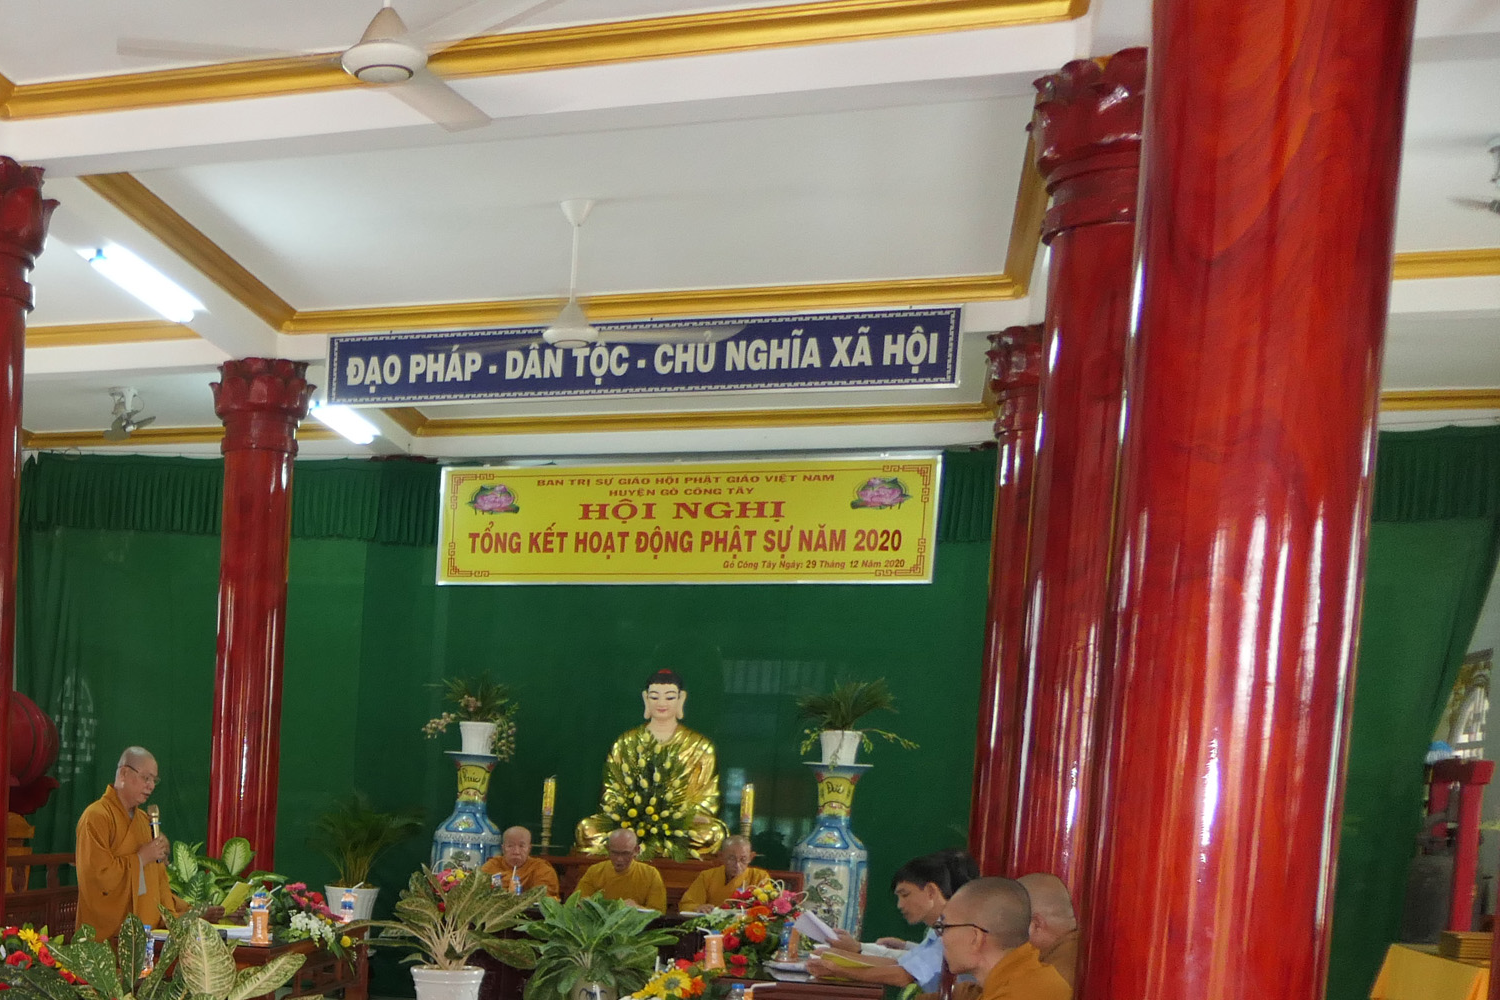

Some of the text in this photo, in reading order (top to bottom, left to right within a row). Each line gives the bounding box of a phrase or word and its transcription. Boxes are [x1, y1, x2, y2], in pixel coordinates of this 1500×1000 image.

[346, 354, 401, 394] ĐẠO
[409, 344, 482, 384] PHÁP
[505, 342, 564, 380] DÂN
[572, 339, 630, 385] TỘC
[653, 329, 717, 375] CHỦ
[724, 328, 822, 372] NGHĨA
[829, 325, 873, 368] XÃ
[882, 325, 940, 374] HỘI
[537, 479, 564, 487] BAN
[569, 478, 591, 487] TRỊ
[618, 476, 651, 486] GIÁO
[655, 475, 679, 486] HỘI
[684, 473, 721, 484] PHẬT
[726, 473, 760, 483] GIÁO
[765, 473, 797, 483] VIỆT
[803, 474, 835, 482] NAM
[609, 488, 656, 498] HUYỆN
[684, 486, 722, 496] CÔNG
[726, 486, 755, 496] TÂY
[578, 498, 787, 524] HỘI NGHỊ
[468, 520, 902, 560] TỔNG KẾT HOẠT ĐỘNG PHẬT SỰ NĂM 2020
[806, 559, 817, 569] 29
[819, 559, 846, 570] Tháng
[850, 559, 859, 569] 12
[861, 559, 882, 568] Năm
[884, 559, 905, 568] 2020
